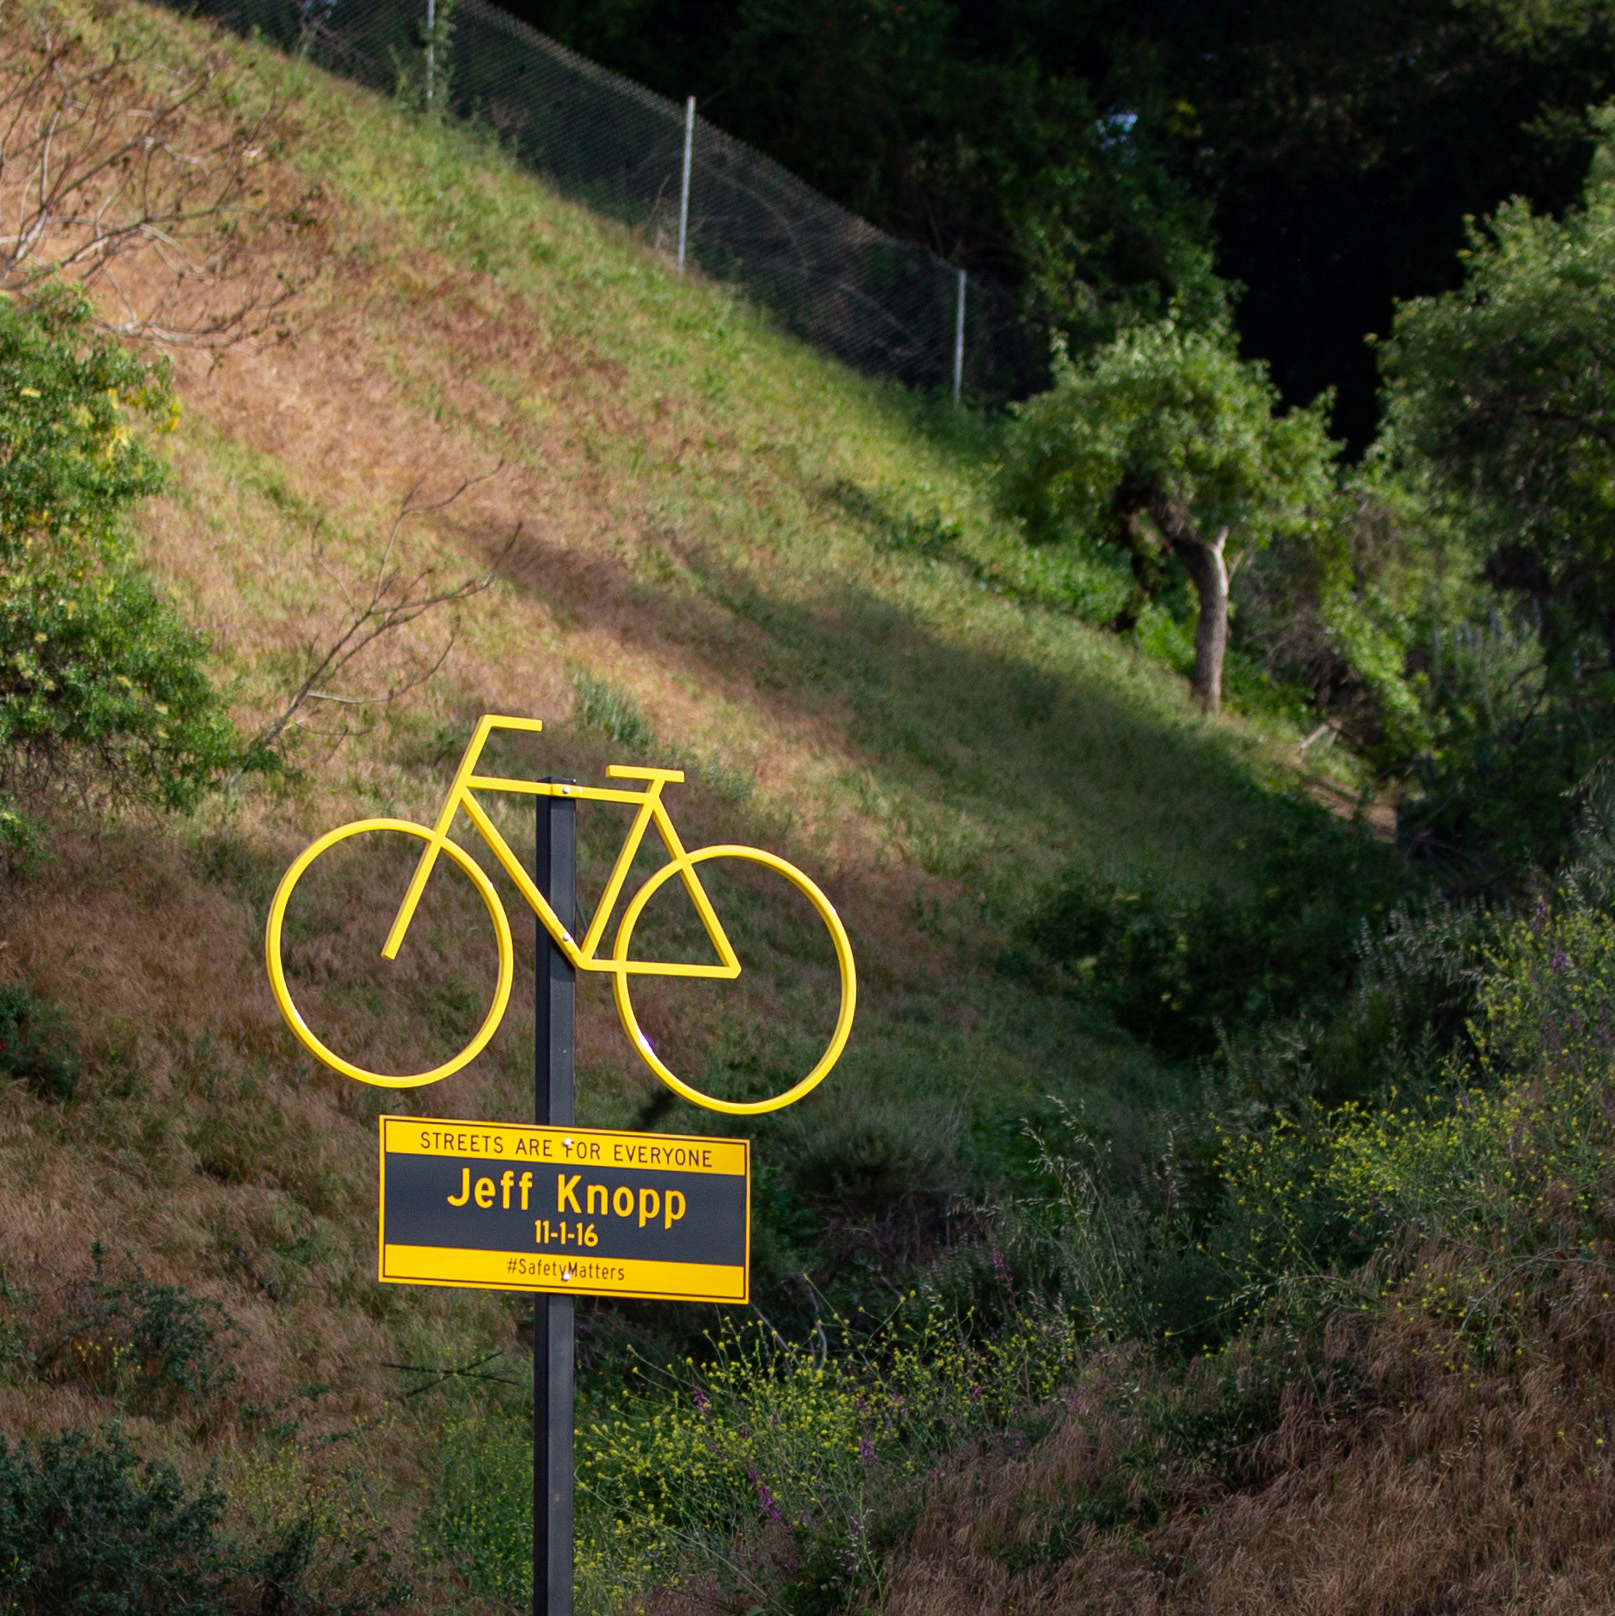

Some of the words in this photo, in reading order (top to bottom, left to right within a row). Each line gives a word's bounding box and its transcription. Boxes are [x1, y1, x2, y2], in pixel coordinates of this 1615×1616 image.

[420, 1131, 503, 1154] STREETS
[515, 1137, 553, 1157] ARE
[565, 1139, 601, 1160] FOR
[613, 1144, 713, 1168] EVERYONE
[446, 1167, 534, 1211] Jeff
[557, 1173, 687, 1230] Knopp
[534, 1219, 599, 1248] 11-1-16
[506, 1257, 625, 1281] #SafetyMatters
